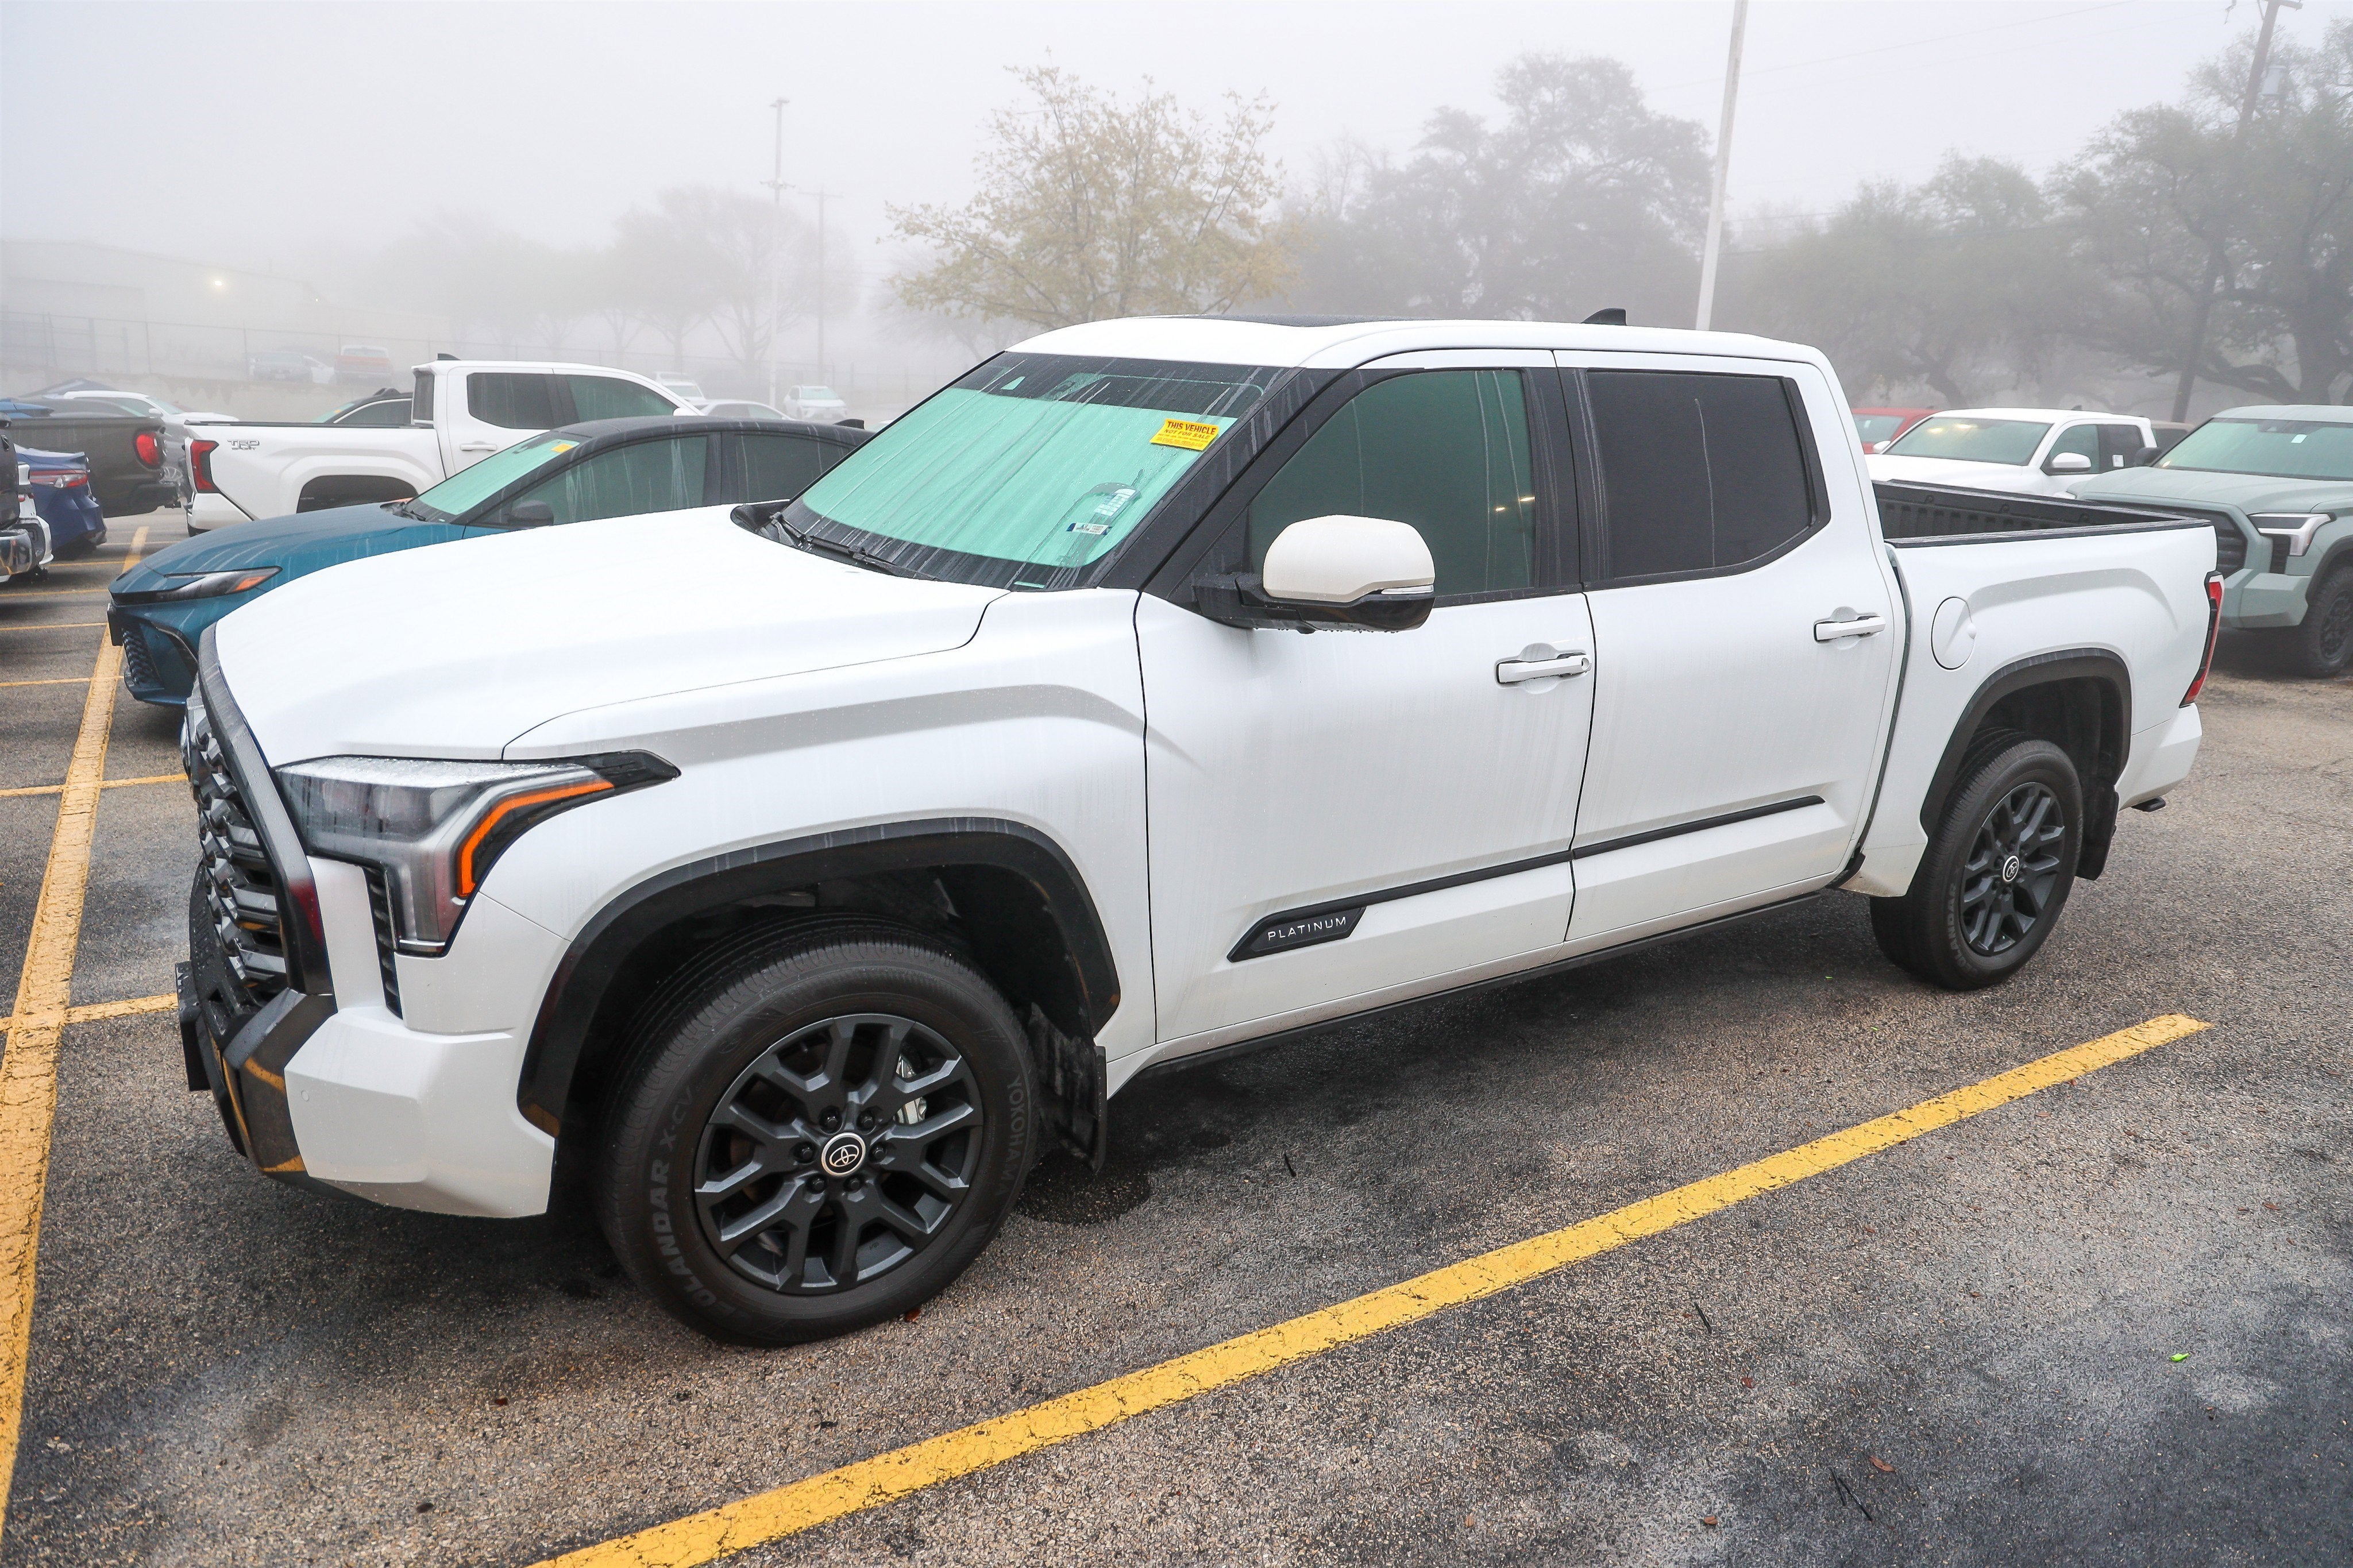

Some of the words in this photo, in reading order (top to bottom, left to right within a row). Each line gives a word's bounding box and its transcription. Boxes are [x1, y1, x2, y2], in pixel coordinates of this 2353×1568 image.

[1167, 421, 1183, 430] THIS
[1186, 424, 1216, 435] VEHICLE
[1267, 916, 1347, 941] PLATINUM
[994, 1074, 1025, 1196] YOKOHAMA
